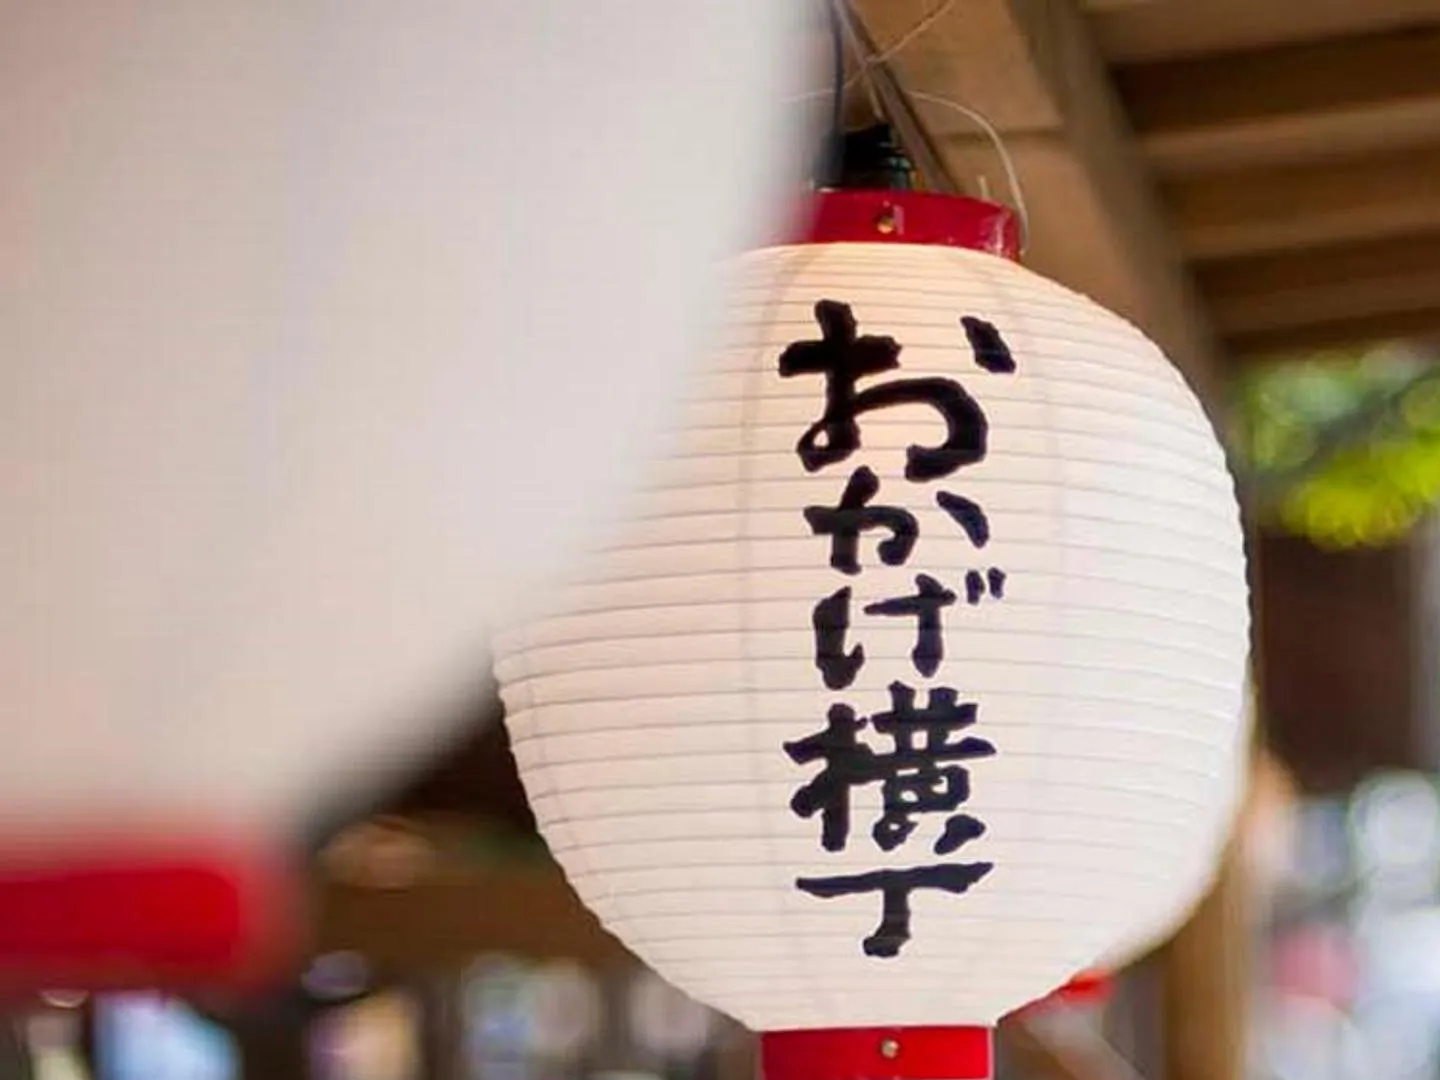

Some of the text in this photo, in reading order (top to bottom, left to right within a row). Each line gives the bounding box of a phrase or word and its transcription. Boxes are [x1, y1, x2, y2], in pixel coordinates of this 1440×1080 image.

[777, 299, 1016, 958] おかげ横丁
